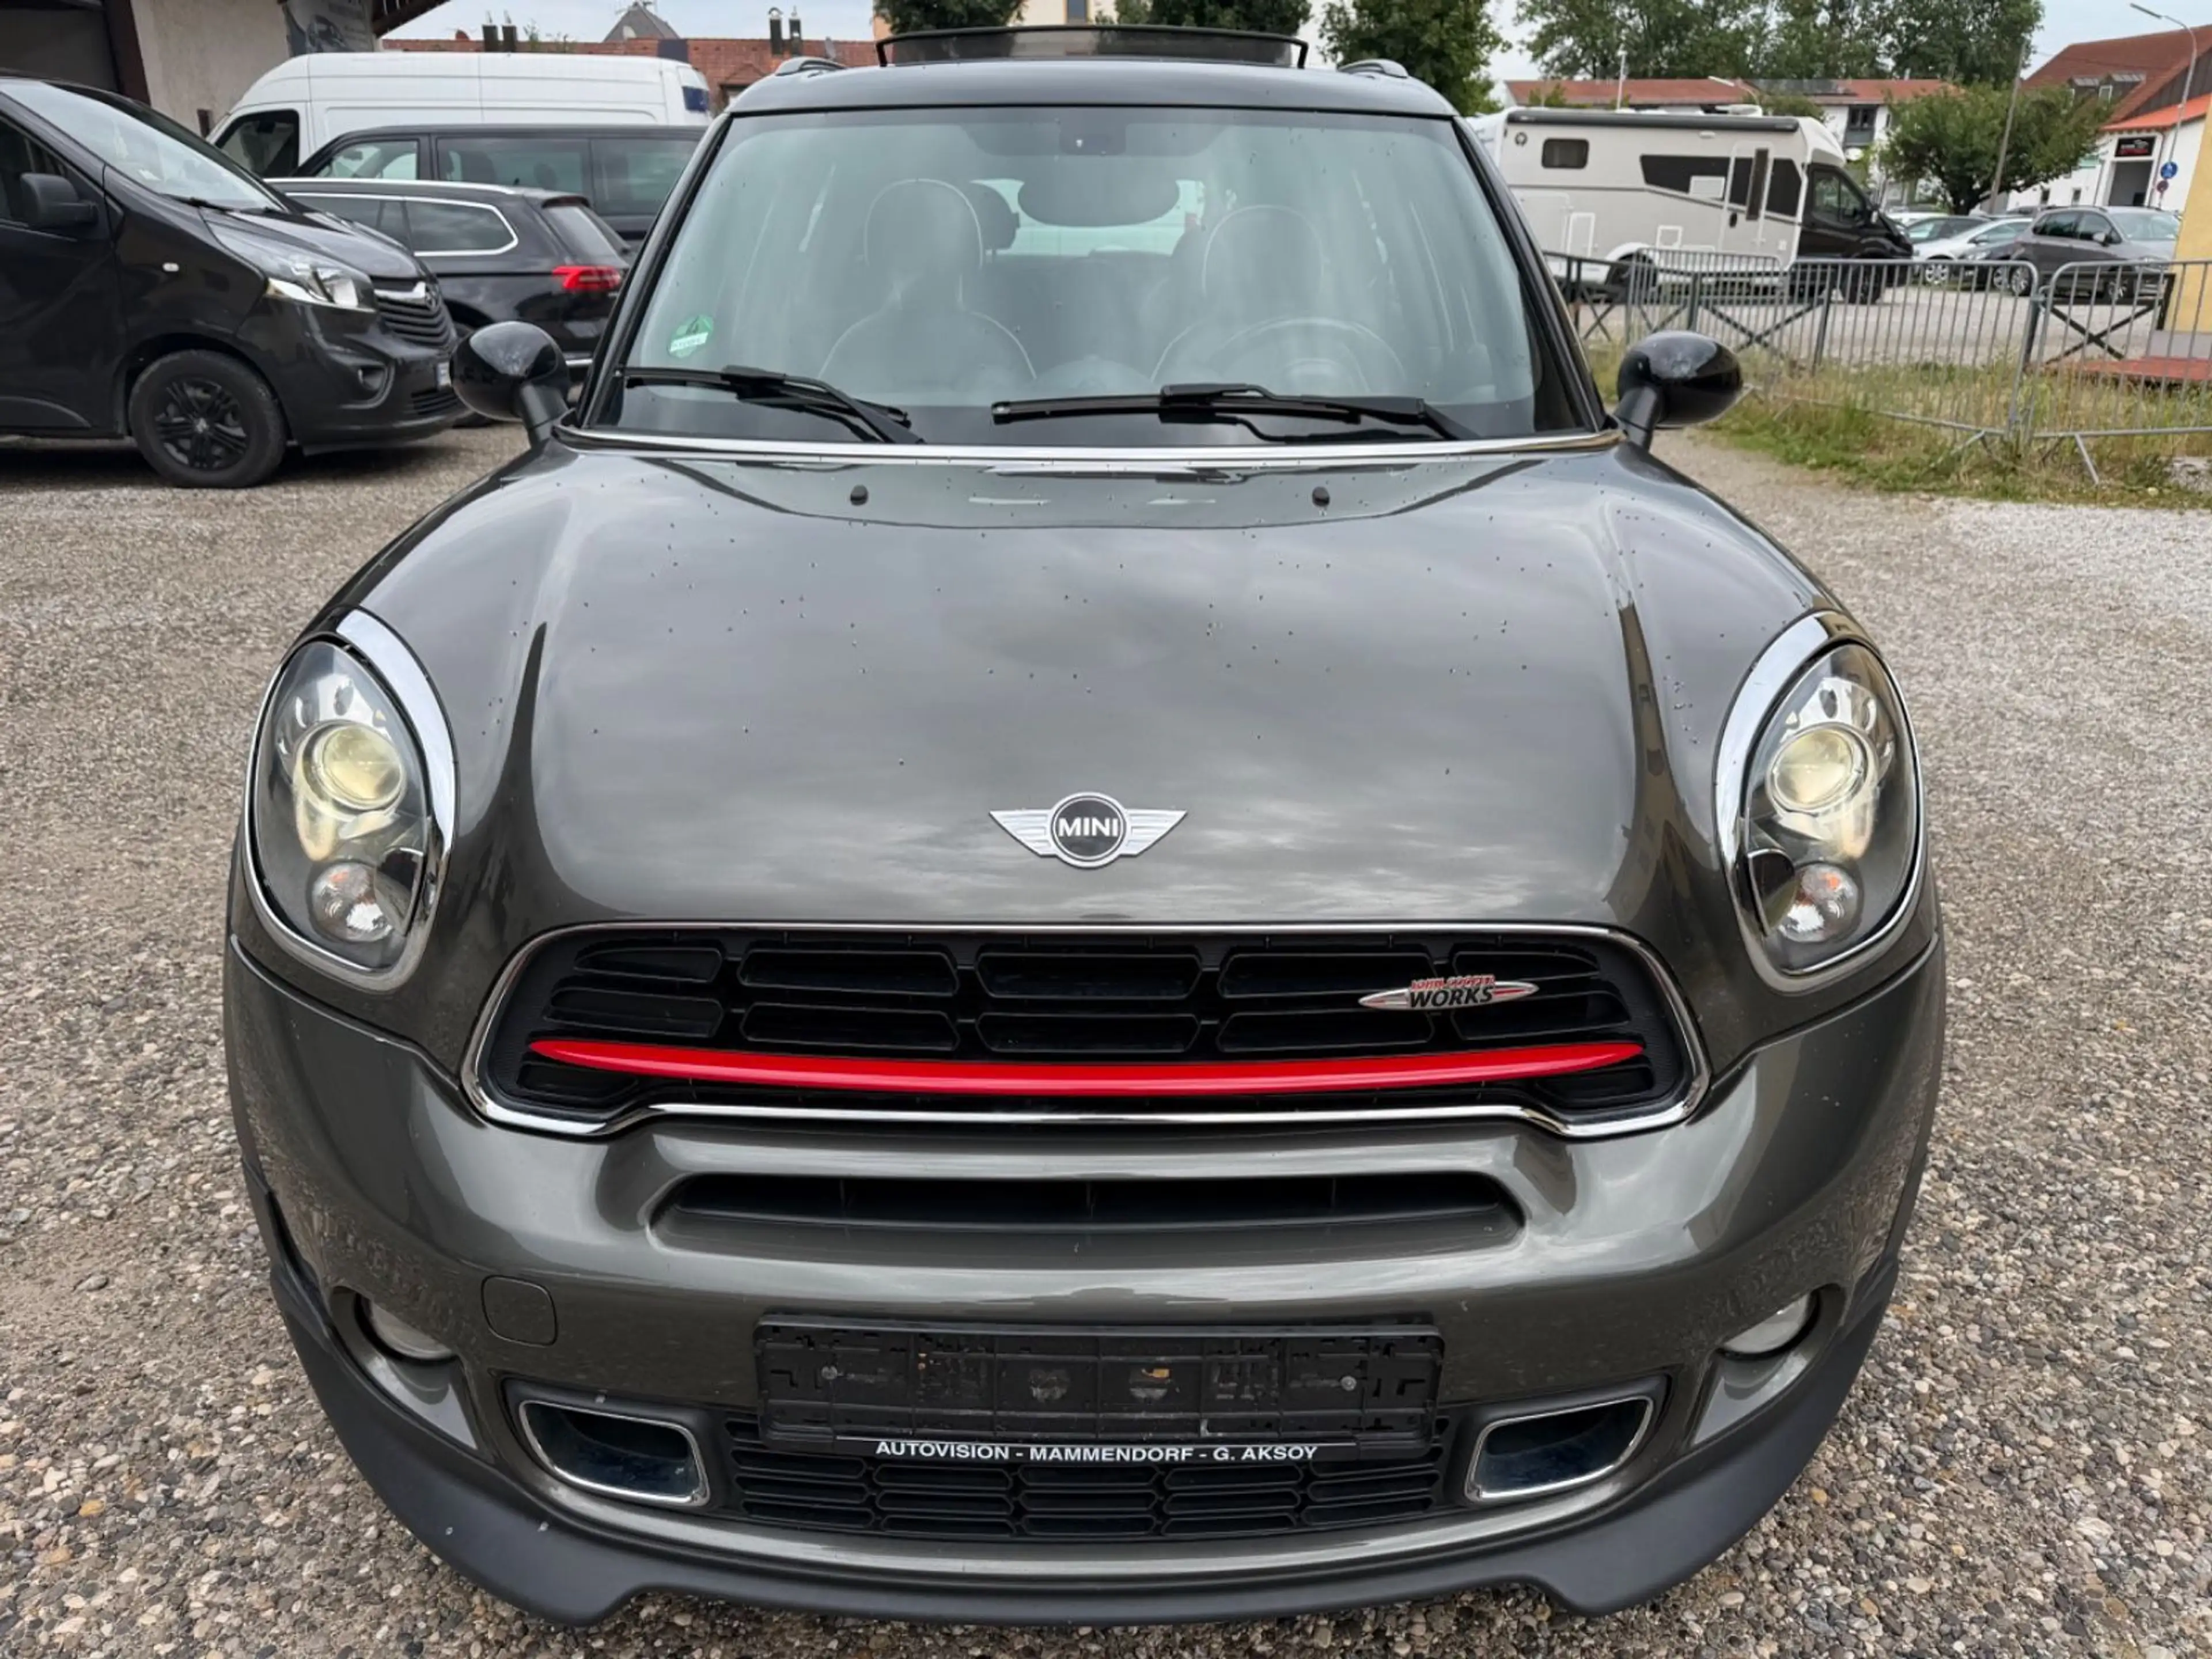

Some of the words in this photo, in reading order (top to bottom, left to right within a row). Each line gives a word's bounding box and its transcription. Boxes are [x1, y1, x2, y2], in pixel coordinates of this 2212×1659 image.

[1059, 817, 1118, 837] MINI
[1410, 986, 1494, 1007] WORKS
[876, 1441, 1009, 1460] AUTOVISION
[1029, 1446, 1194, 1461] MAMMENDORF
[1213, 1446, 1235, 1461] G.
[1241, 1445, 1318, 1461] AKSOY
